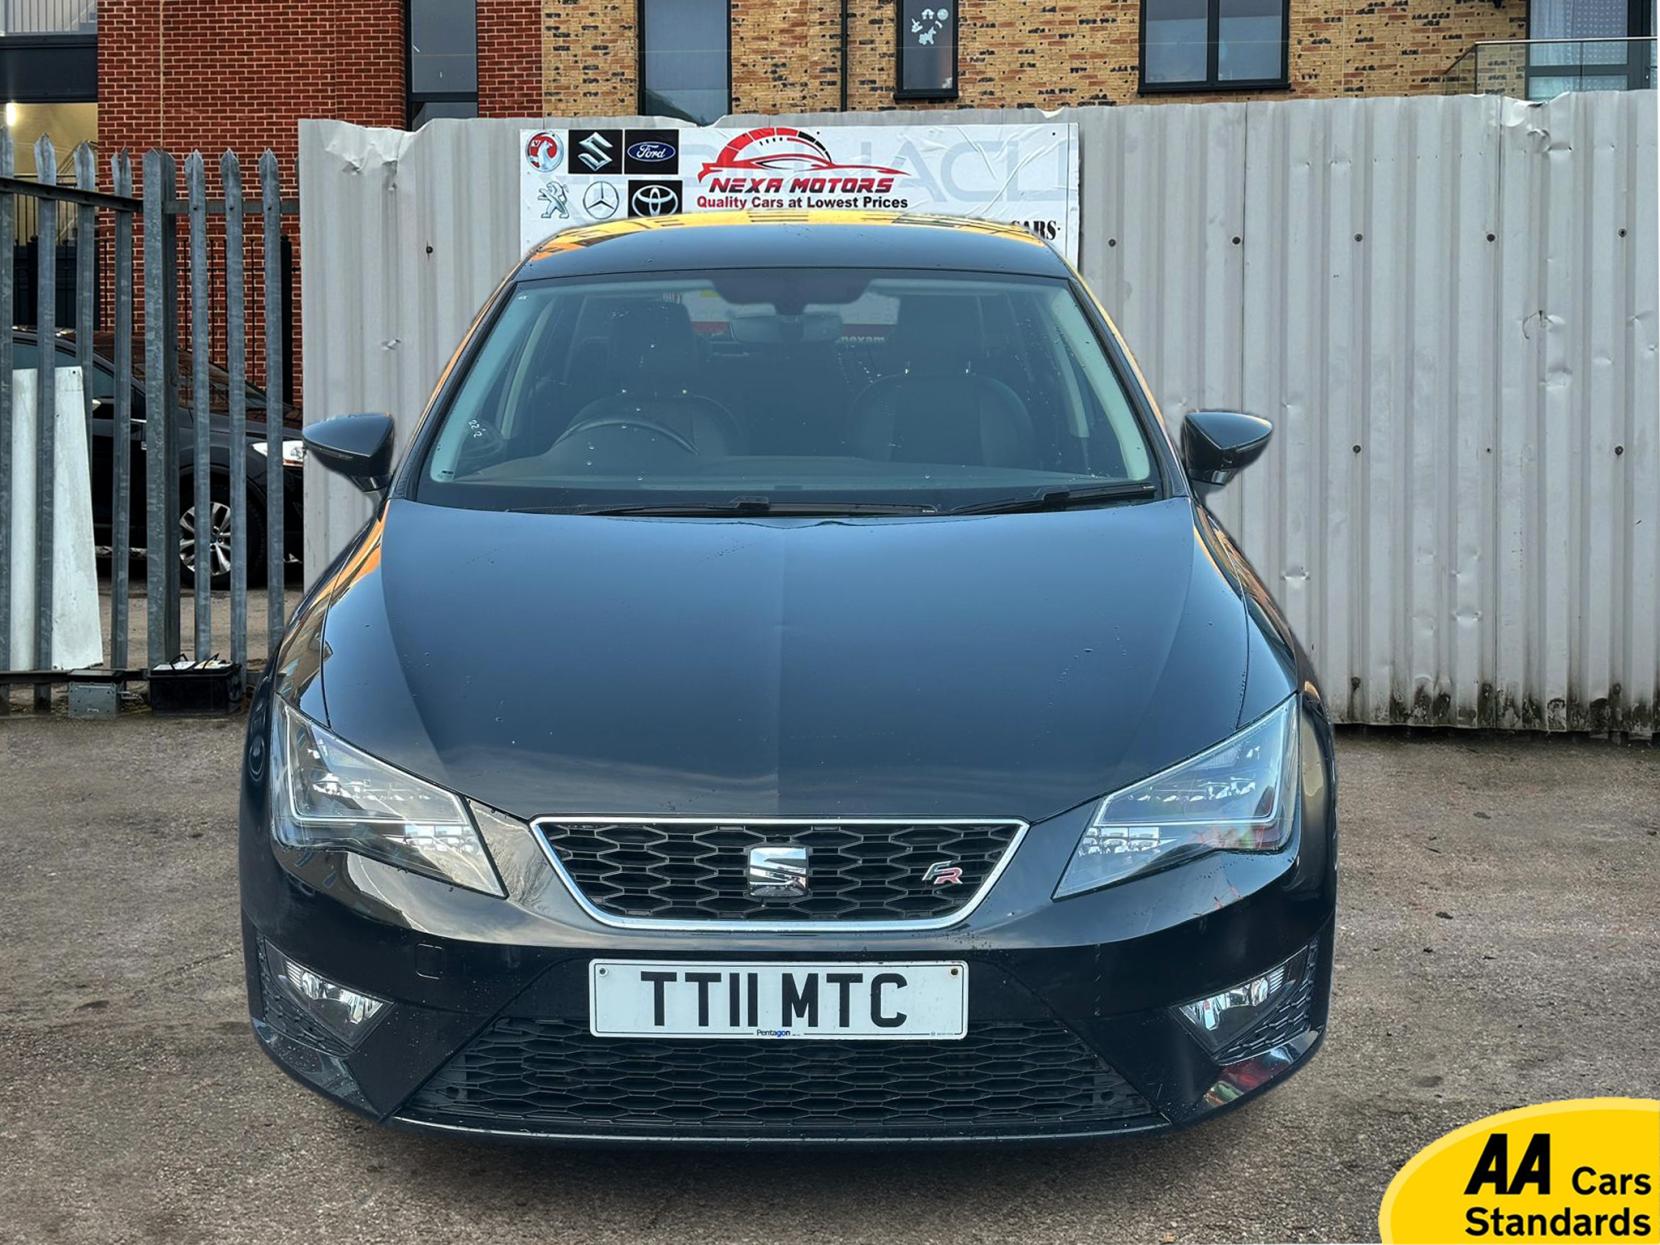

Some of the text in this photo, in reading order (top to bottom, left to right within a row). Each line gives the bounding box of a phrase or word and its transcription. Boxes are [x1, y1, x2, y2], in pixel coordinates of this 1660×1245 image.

[635, 144, 667, 159] Ford
[709, 177, 895, 194] NEXA MOTORS
[697, 196, 908, 209] Quality Cars at Lowest Prices
[922, 860, 963, 885] FR
[782, 973, 908, 1028] MTC
[757, 1028, 791, 1038] Pentagon
